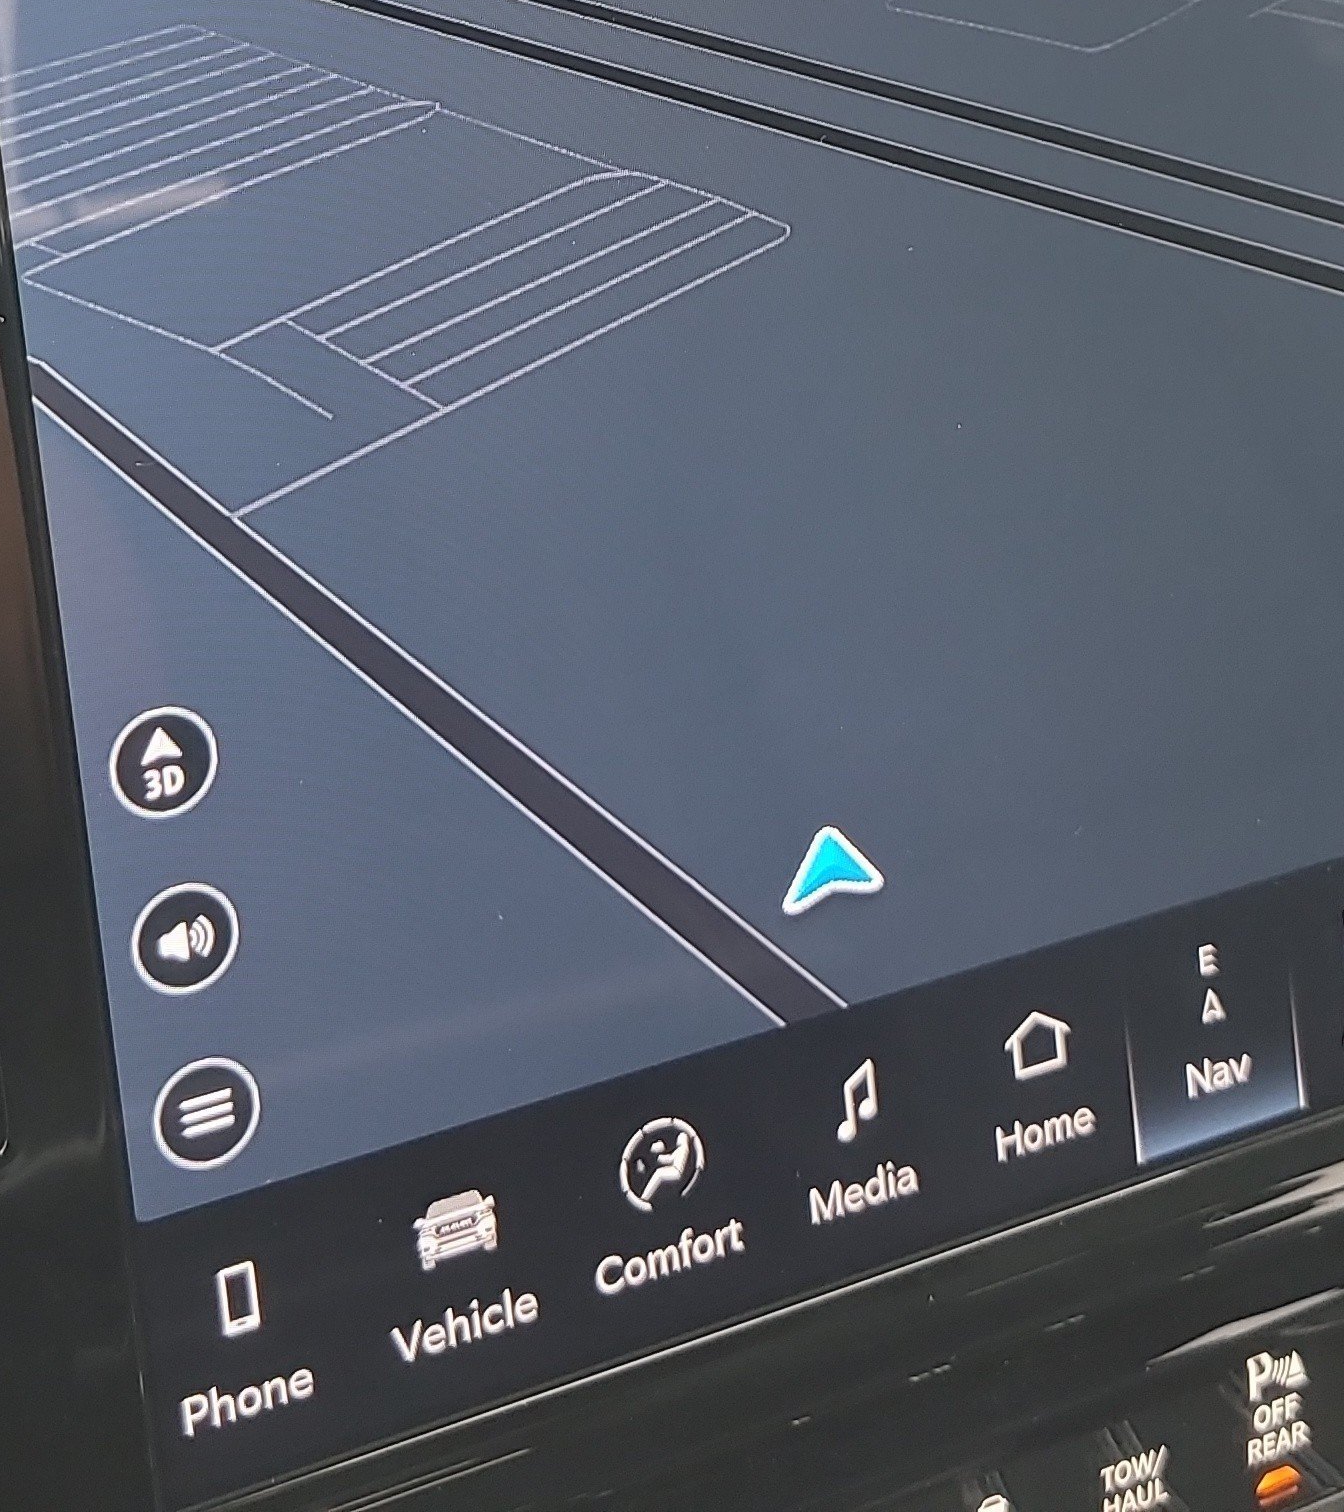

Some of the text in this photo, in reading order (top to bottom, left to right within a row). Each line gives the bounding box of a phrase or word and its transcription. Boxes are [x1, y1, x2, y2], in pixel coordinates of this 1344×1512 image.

[143, 764, 186, 801] 3D
[1198, 943, 1220, 977] E
[1185, 1052, 1254, 1100] Nav
[995, 1105, 1098, 1164] Home
[809, 1161, 920, 1226] Media
[596, 1218, 746, 1296] Comfort
[391, 1288, 540, 1363] Vehicle
[181, 1364, 316, 1437] Phone
[1253, 1392, 1303, 1433] OFF
[1247, 1420, 1312, 1468] REAR
[1103, 1484, 1170, 1512] HAUL
